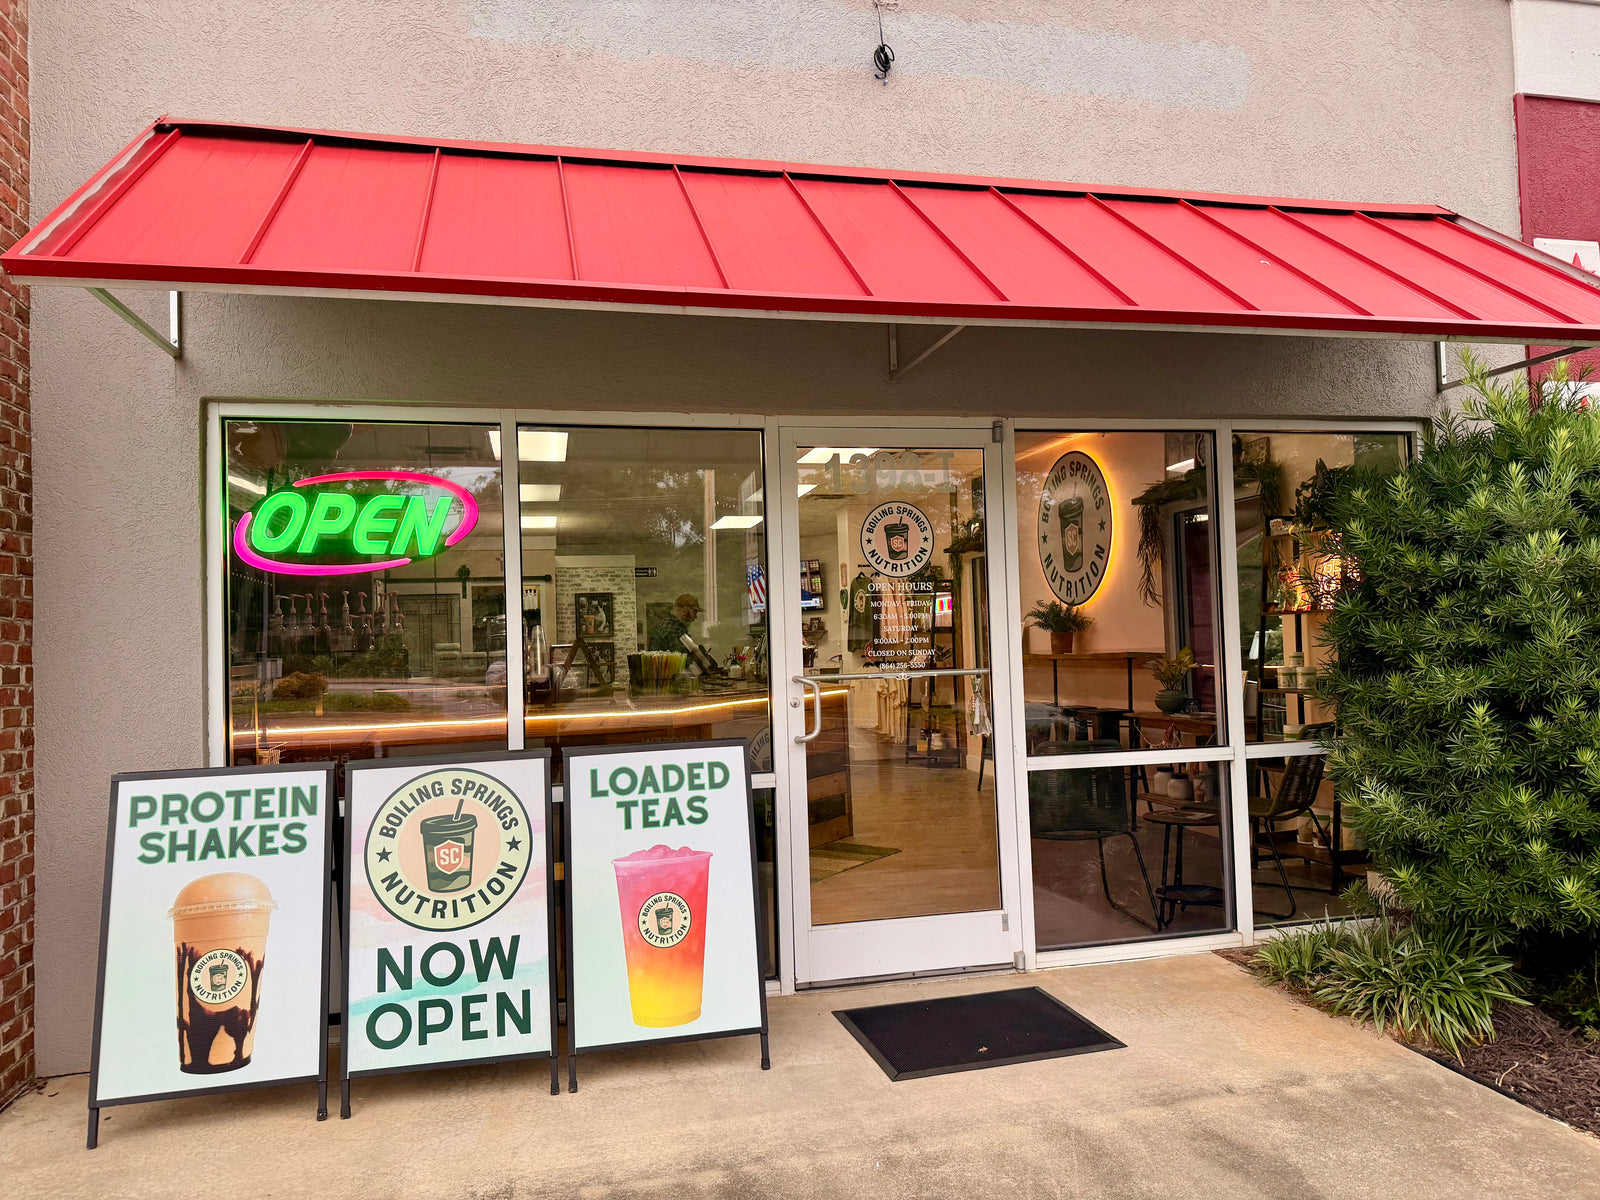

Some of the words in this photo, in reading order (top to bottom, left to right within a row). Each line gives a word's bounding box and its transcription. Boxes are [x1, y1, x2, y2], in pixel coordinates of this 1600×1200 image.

[1041, 465, 1067, 524] BOING
[1069, 460, 1105, 511] SPRINGS
[251, 491, 453, 556] OPEN
[866, 506, 894, 534] BOILING
[896, 505, 928, 533] SPRINGS
[893, 539, 903, 548] SC
[1066, 530, 1077, 546] SC
[868, 546, 928, 573] NUTRITION
[1044, 543, 1106, 598] NUTRITION
[867, 582, 895, 592] OPEN
[897, 581, 933, 591] HOURS
[870, 600, 901, 608] MONDAY
[906, 599, 931, 607] FRIDAY
[867, 649, 895, 657] CLOSED
[896, 649, 907, 657] ON
[908, 648, 936, 656] SUNDAY
[589, 761, 730, 798] LOADED
[129, 784, 319, 828] PROTEIN
[378, 780, 445, 839] BOILING
[450, 778, 519, 831] SPRINGS
[616, 795, 709, 830] TEAS
[137, 822, 308, 865] SHAKES
[439, 847, 460, 866] SC
[380, 861, 518, 919] NUTRITION
[642, 896, 663, 917] BOILING
[664, 895, 687, 914] SPRINGS
[643, 924, 687, 944] NUTRITION
[195, 953, 218, 974] BOILING
[219, 951, 243, 971] SPRINGS
[376, 934, 521, 993] NOW
[195, 980, 242, 1000] NUTRITION
[365, 988, 532, 1050] OPEN
